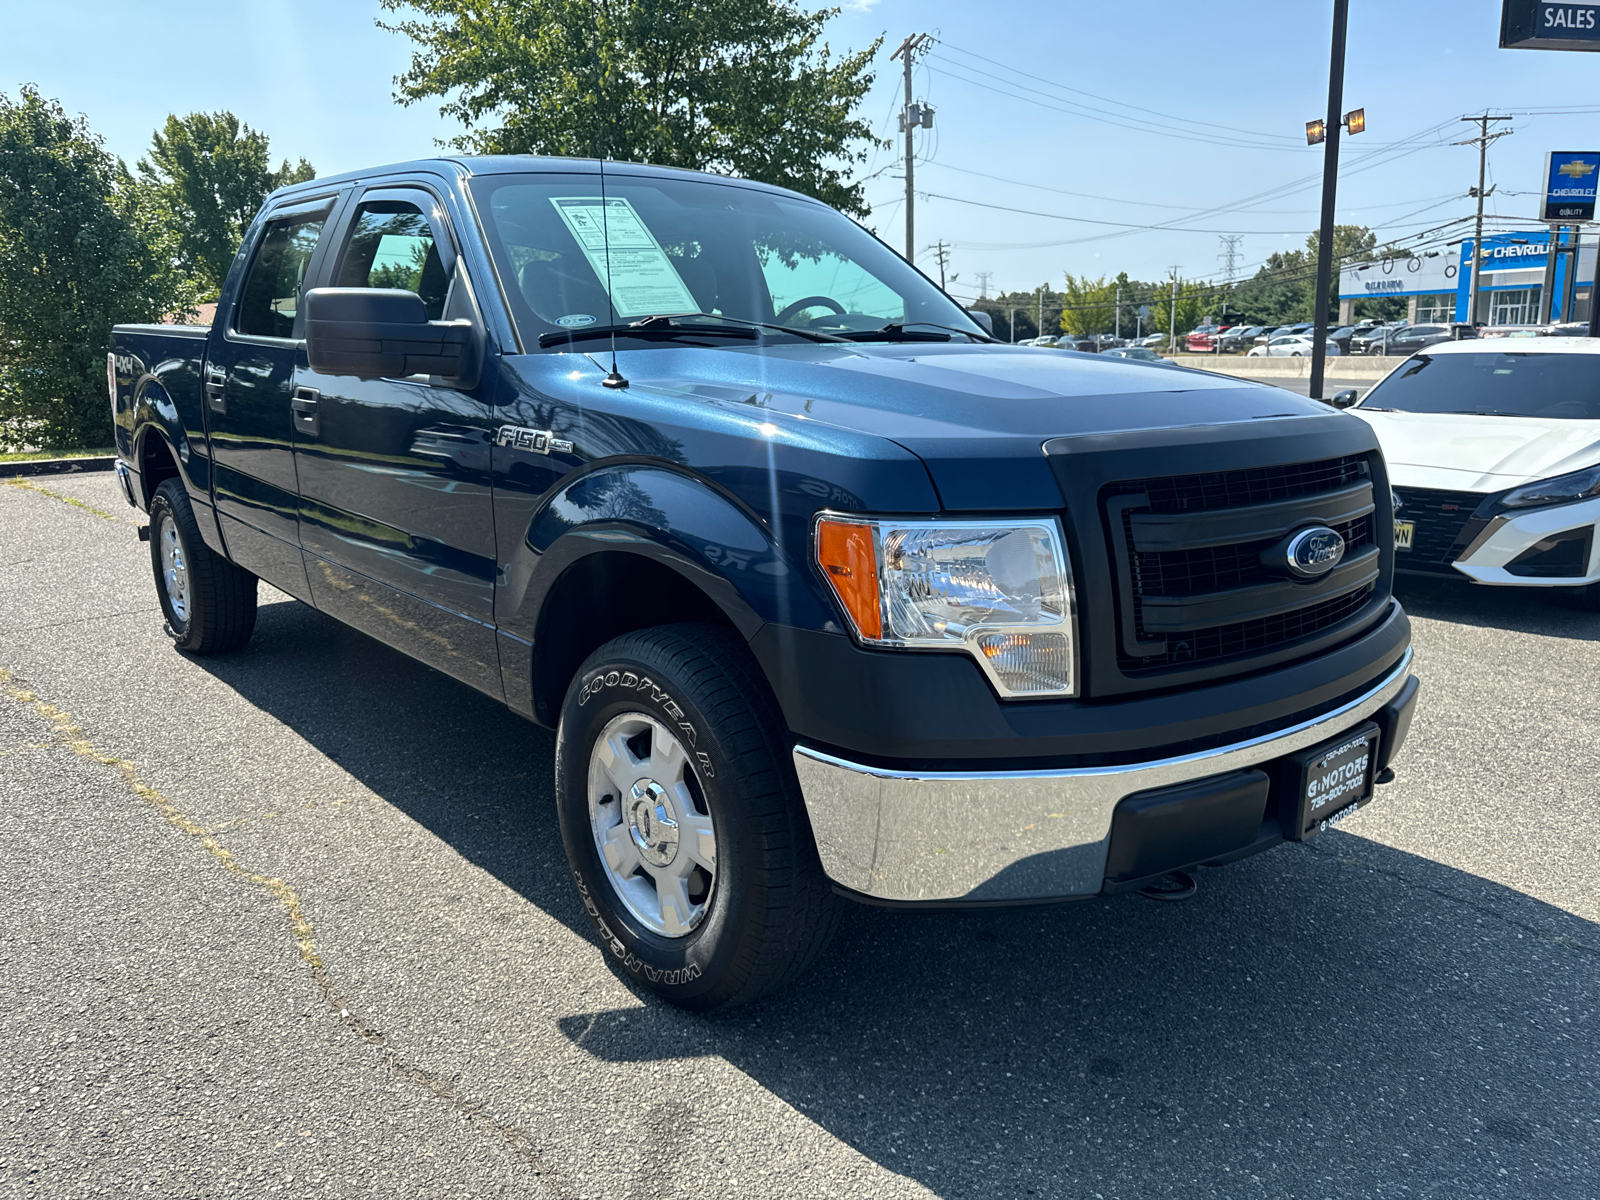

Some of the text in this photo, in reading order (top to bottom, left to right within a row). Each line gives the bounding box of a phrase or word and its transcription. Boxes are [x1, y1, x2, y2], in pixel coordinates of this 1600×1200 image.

[1544, 7, 1595, 29] SALES
[1552, 188, 1595, 197] CHEVROLET
[1559, 208, 1583, 217] QUALITY
[1493, 244, 1553, 258] CHEVROL
[1307, 535, 1343, 565] Ford
[578, 671, 715, 778] GOODYEAR
[1311, 774, 1364, 811] 732-800-7003
[575, 871, 702, 985] WRANGLER
